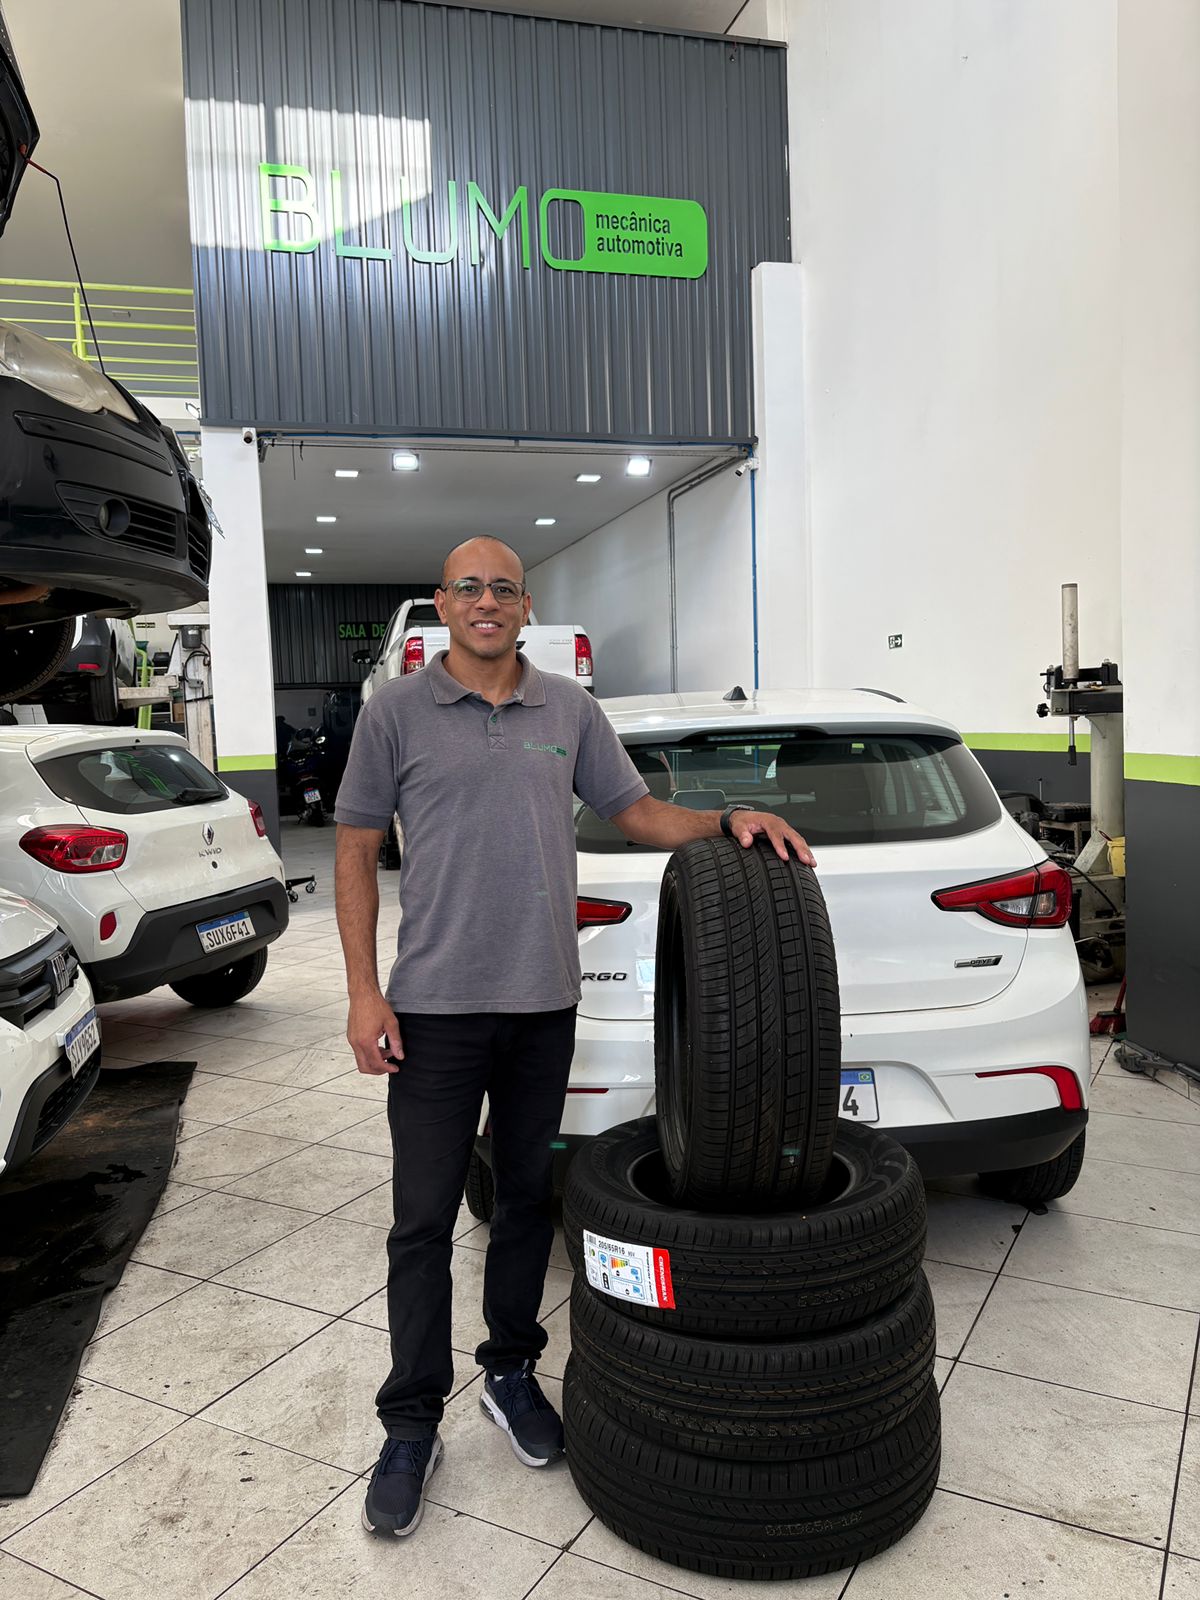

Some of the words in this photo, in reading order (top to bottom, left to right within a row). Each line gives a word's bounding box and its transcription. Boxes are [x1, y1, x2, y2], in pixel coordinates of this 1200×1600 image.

[259, 162, 588, 270] BLUMO
[595, 211, 671, 235] mecânica
[596, 234, 684, 259] automotiva
[339, 623, 367, 638] SALA
[371, 623, 386, 638] DE
[523, 741, 557, 753] BLUMO
[199, 847, 222, 858] KWID
[206, 921, 251, 948] SUX6F41
[581, 972, 628, 981] RGO
